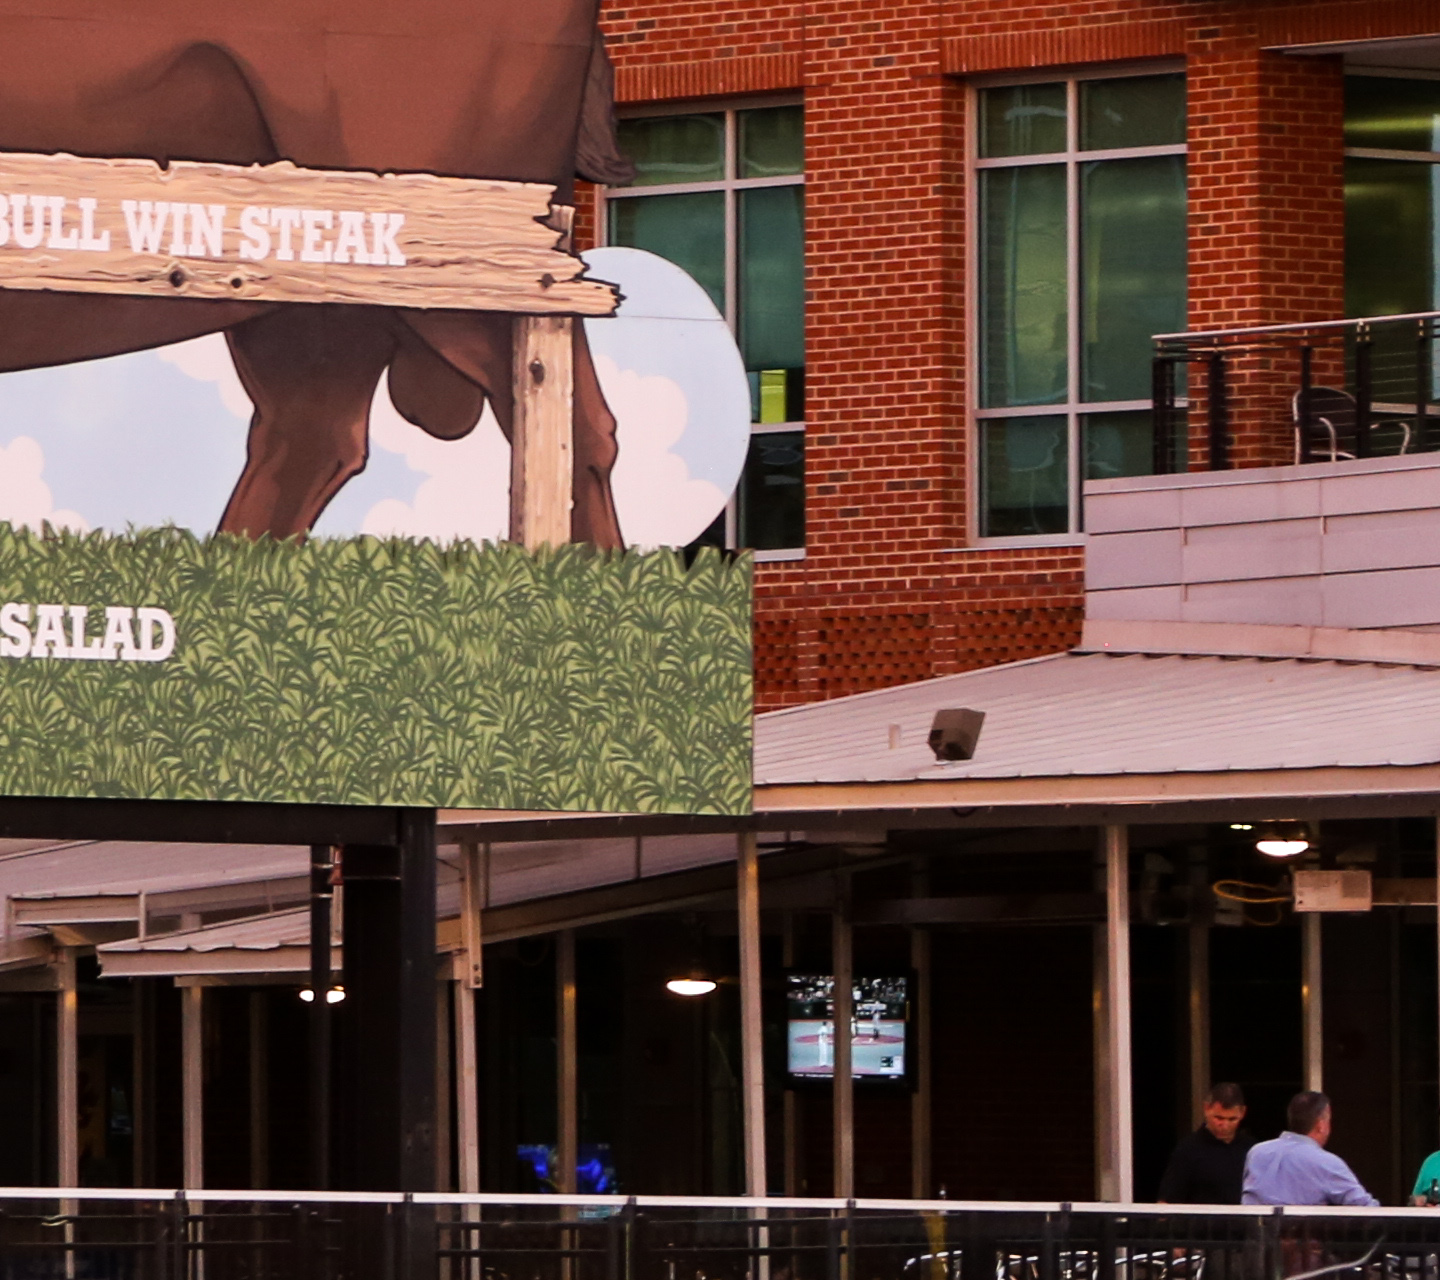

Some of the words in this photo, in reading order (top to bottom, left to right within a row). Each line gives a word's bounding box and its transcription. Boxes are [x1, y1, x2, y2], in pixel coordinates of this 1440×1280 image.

[121, 199, 227, 258] WIN
[237, 205, 407, 266] STEAK
[0, 602, 175, 662] SALAD
